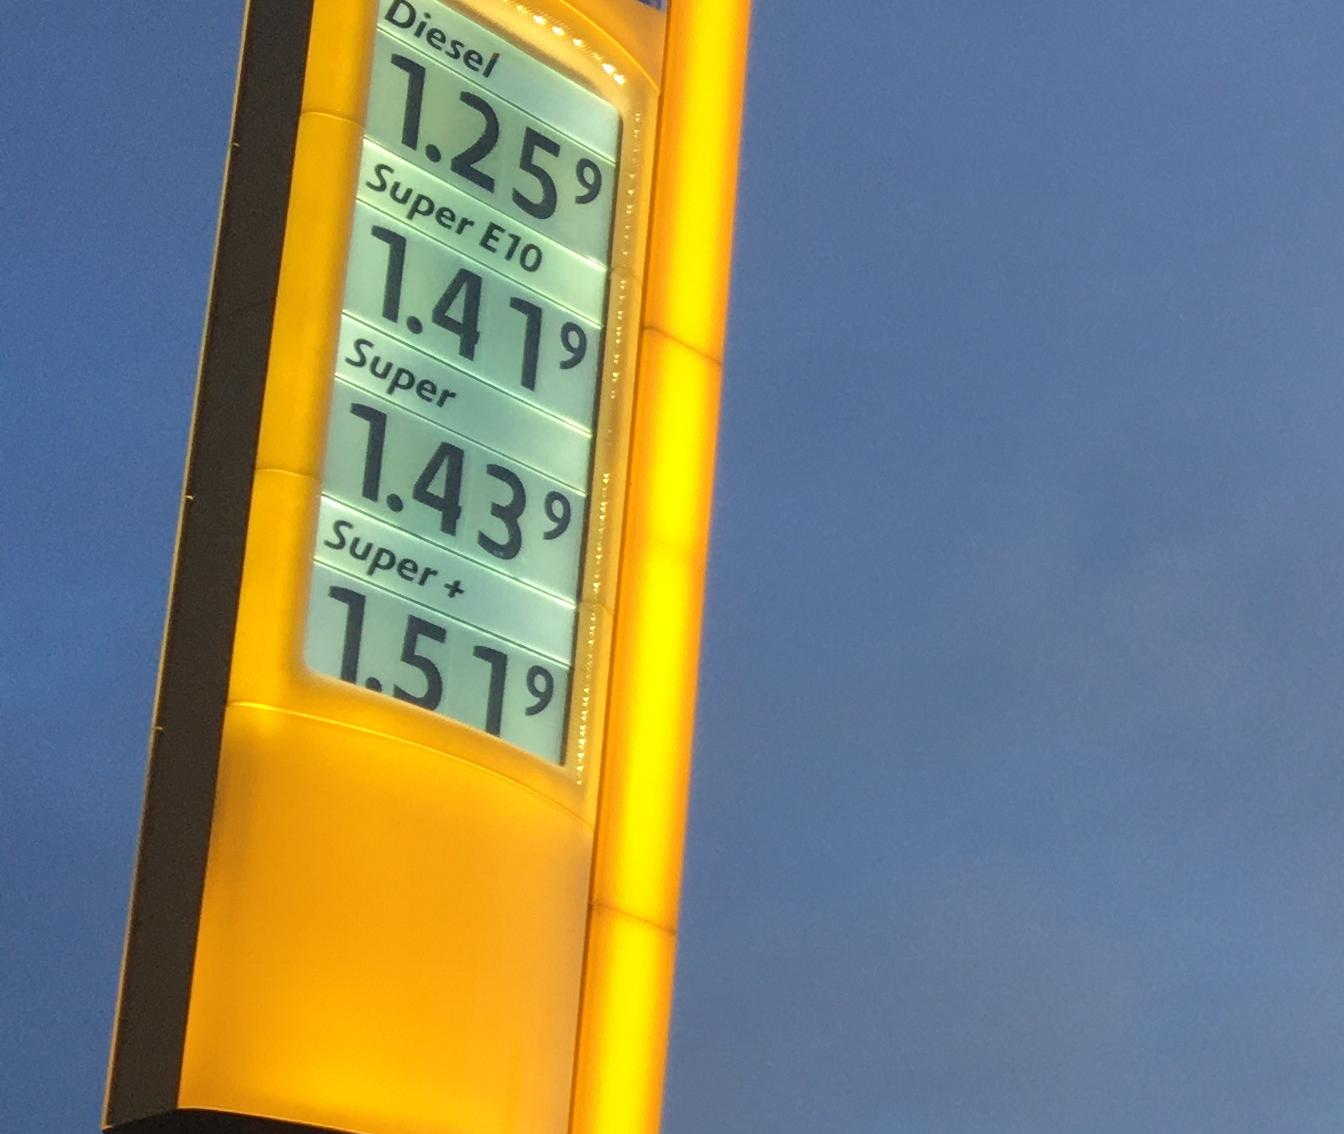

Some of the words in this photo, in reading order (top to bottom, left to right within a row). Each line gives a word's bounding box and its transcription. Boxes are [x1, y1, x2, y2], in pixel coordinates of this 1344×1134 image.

[384, 0, 500, 78] Diesel
[366, 163, 474, 237] Super
[479, 225, 543, 273] E10
[345, 338, 456, 408] Super
[324, 519, 438, 587] Super
